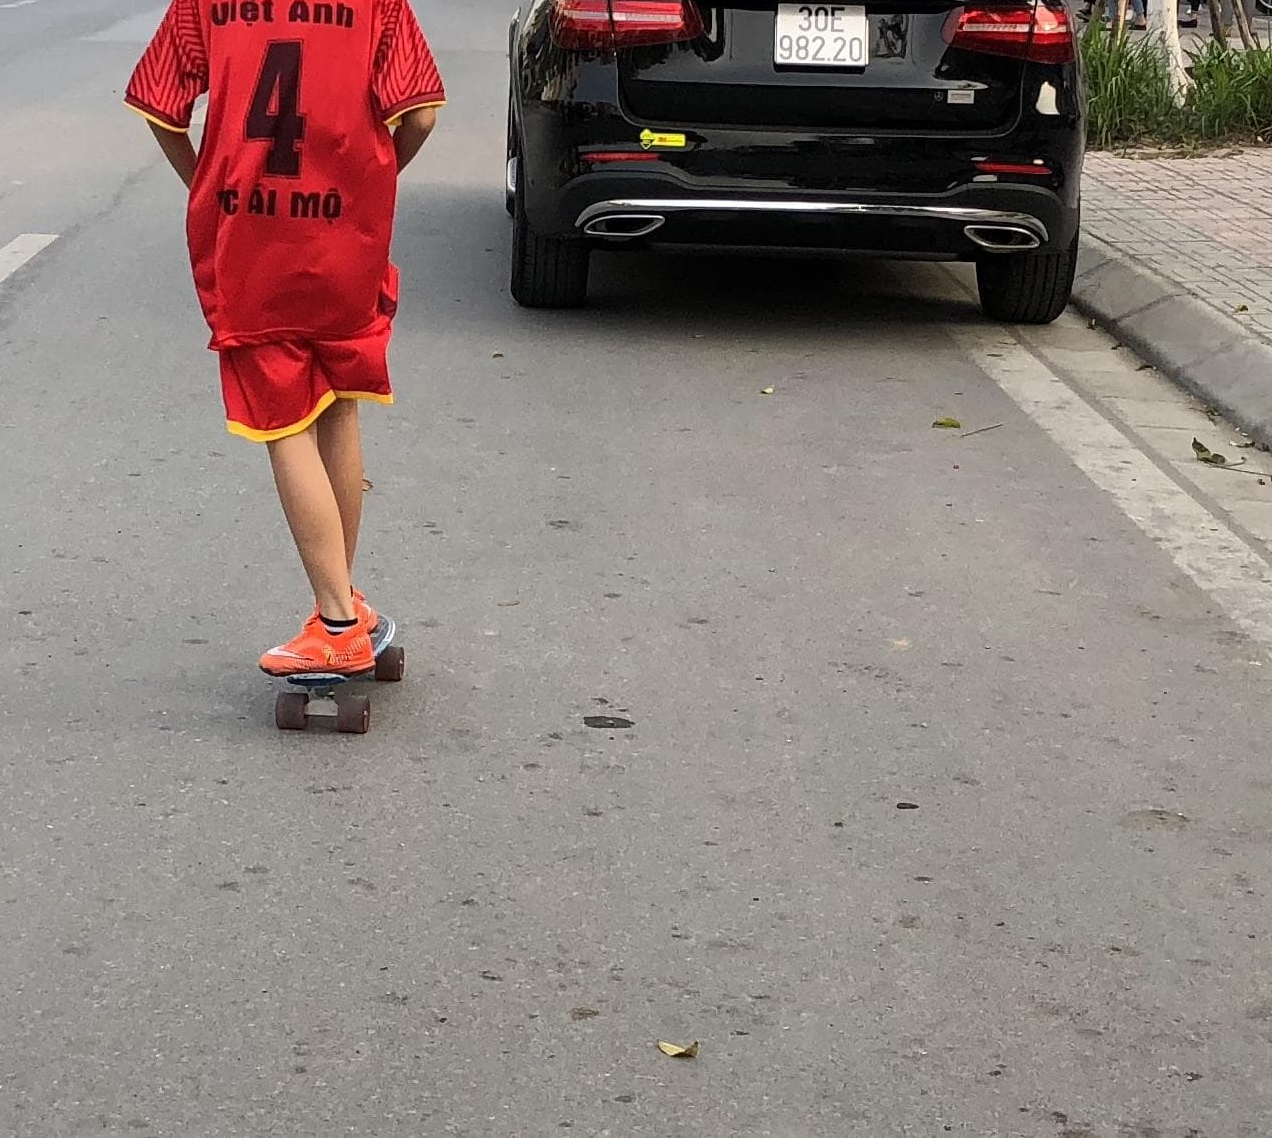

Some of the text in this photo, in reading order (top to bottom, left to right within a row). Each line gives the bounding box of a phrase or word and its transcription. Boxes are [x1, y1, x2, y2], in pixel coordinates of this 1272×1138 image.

[798, 6, 845, 33] 30E
[779, 35, 863, 62] 982.20
[244, 39, 306, 179] 4
[290, 188, 342, 225] MỘ
